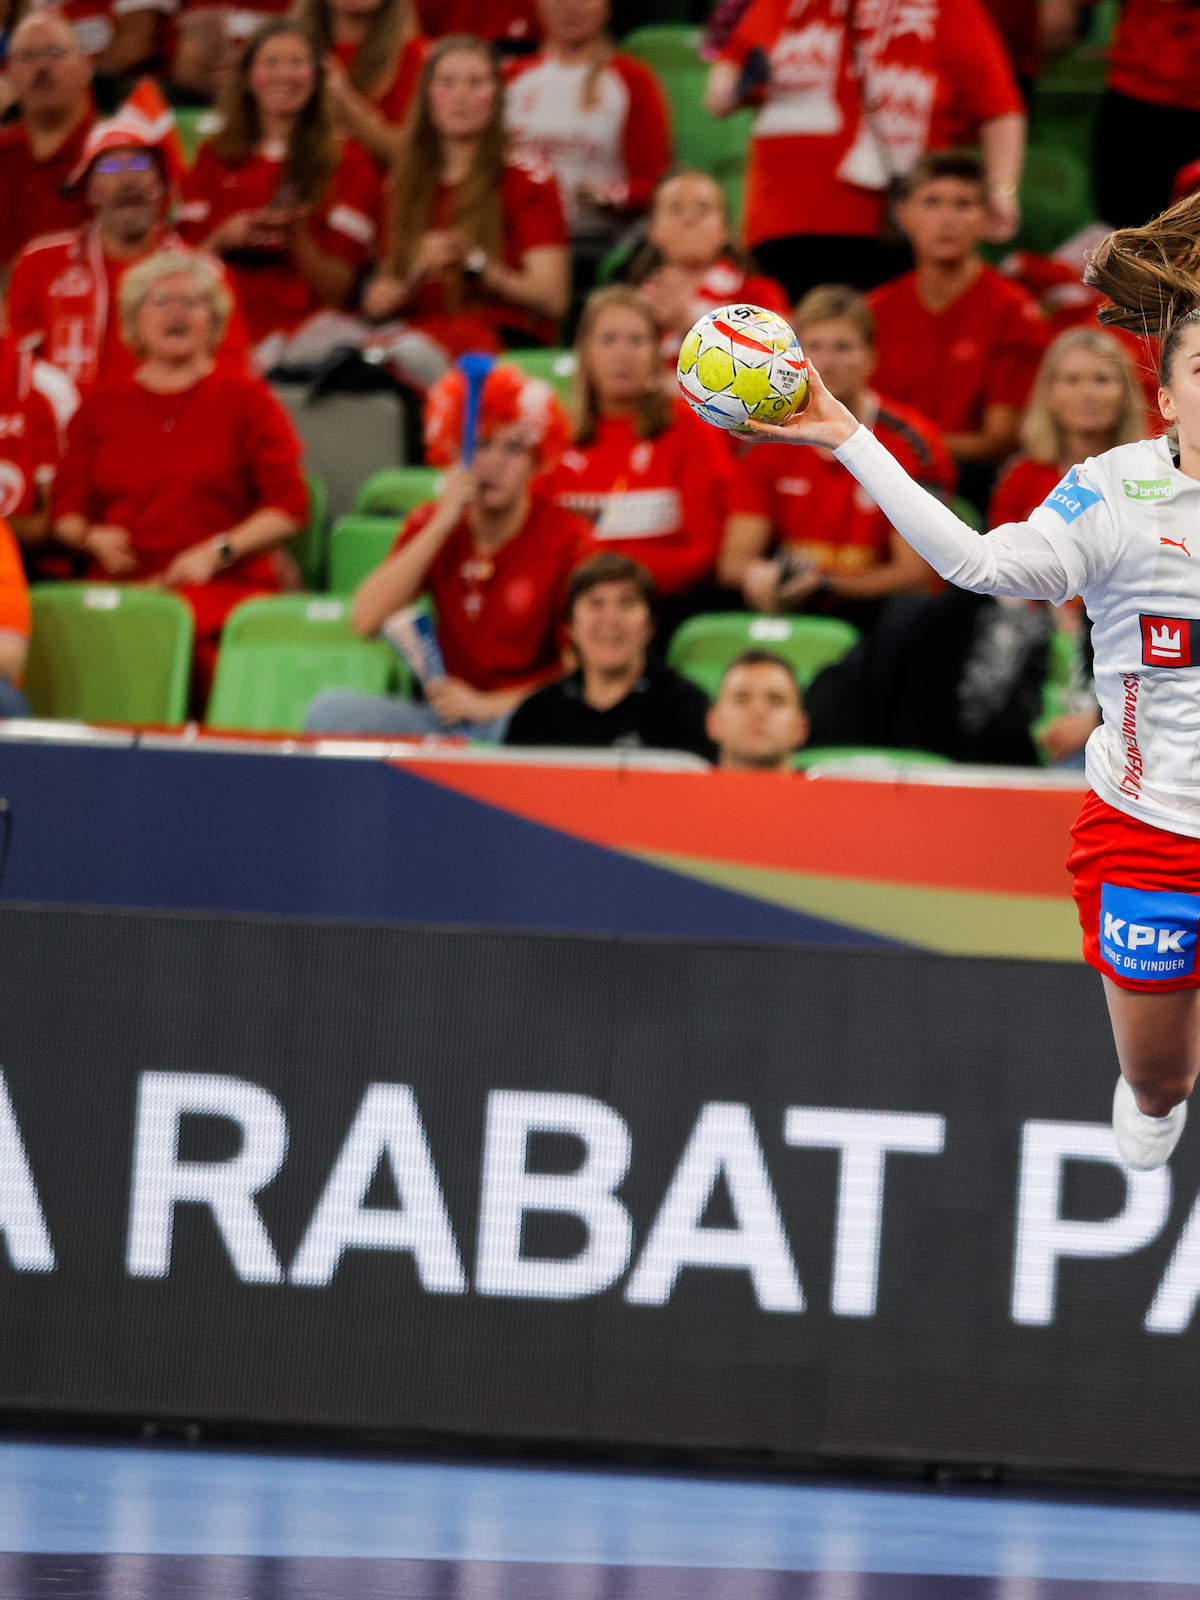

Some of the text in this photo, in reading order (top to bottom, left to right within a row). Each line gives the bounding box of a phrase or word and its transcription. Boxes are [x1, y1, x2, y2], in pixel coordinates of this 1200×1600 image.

[1139, 485, 1173, 497] bring
[1103, 911, 1188, 954] KPK
[1123, 956, 1138, 970] OG
[1140, 959, 1185, 972] VINDUER
[126, 1069, 946, 1317] RABAT
